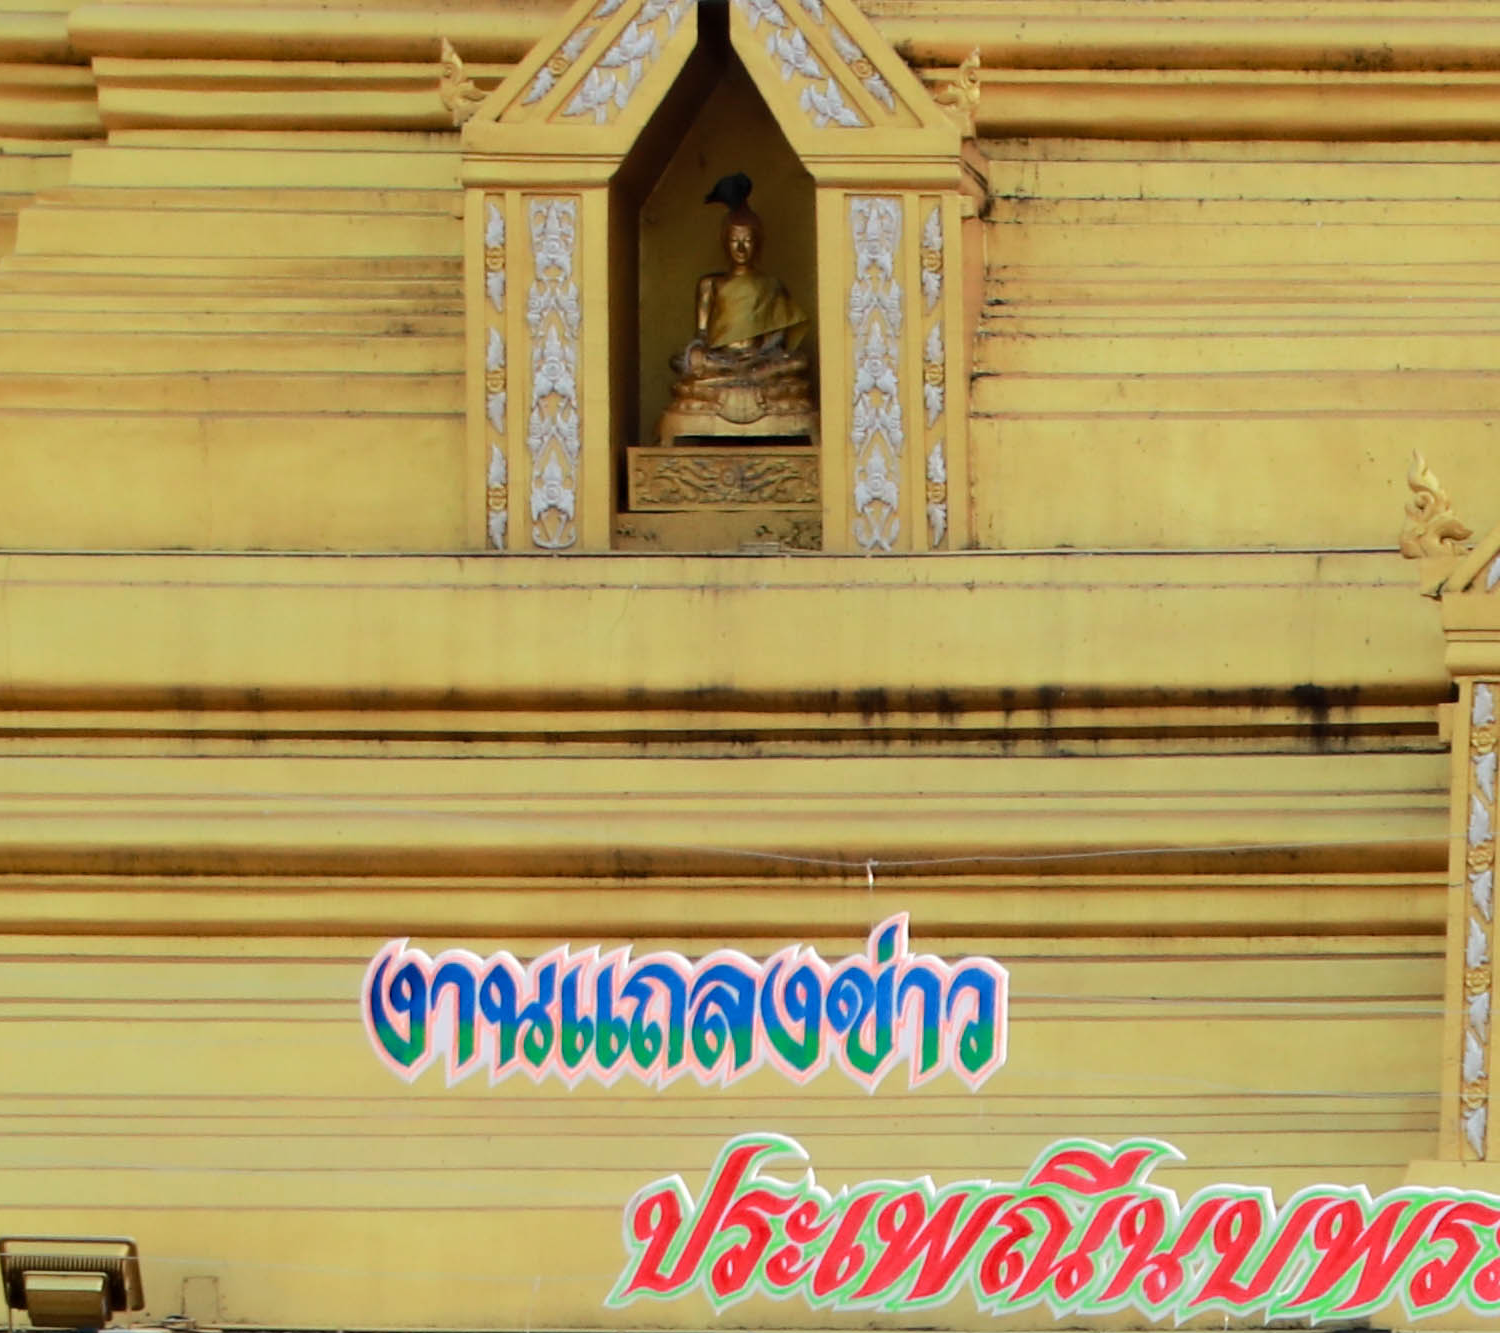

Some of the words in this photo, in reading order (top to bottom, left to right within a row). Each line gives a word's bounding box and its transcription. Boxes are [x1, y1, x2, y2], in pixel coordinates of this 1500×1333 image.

[368, 918, 1005, 1085] งานแถลงข่าว
